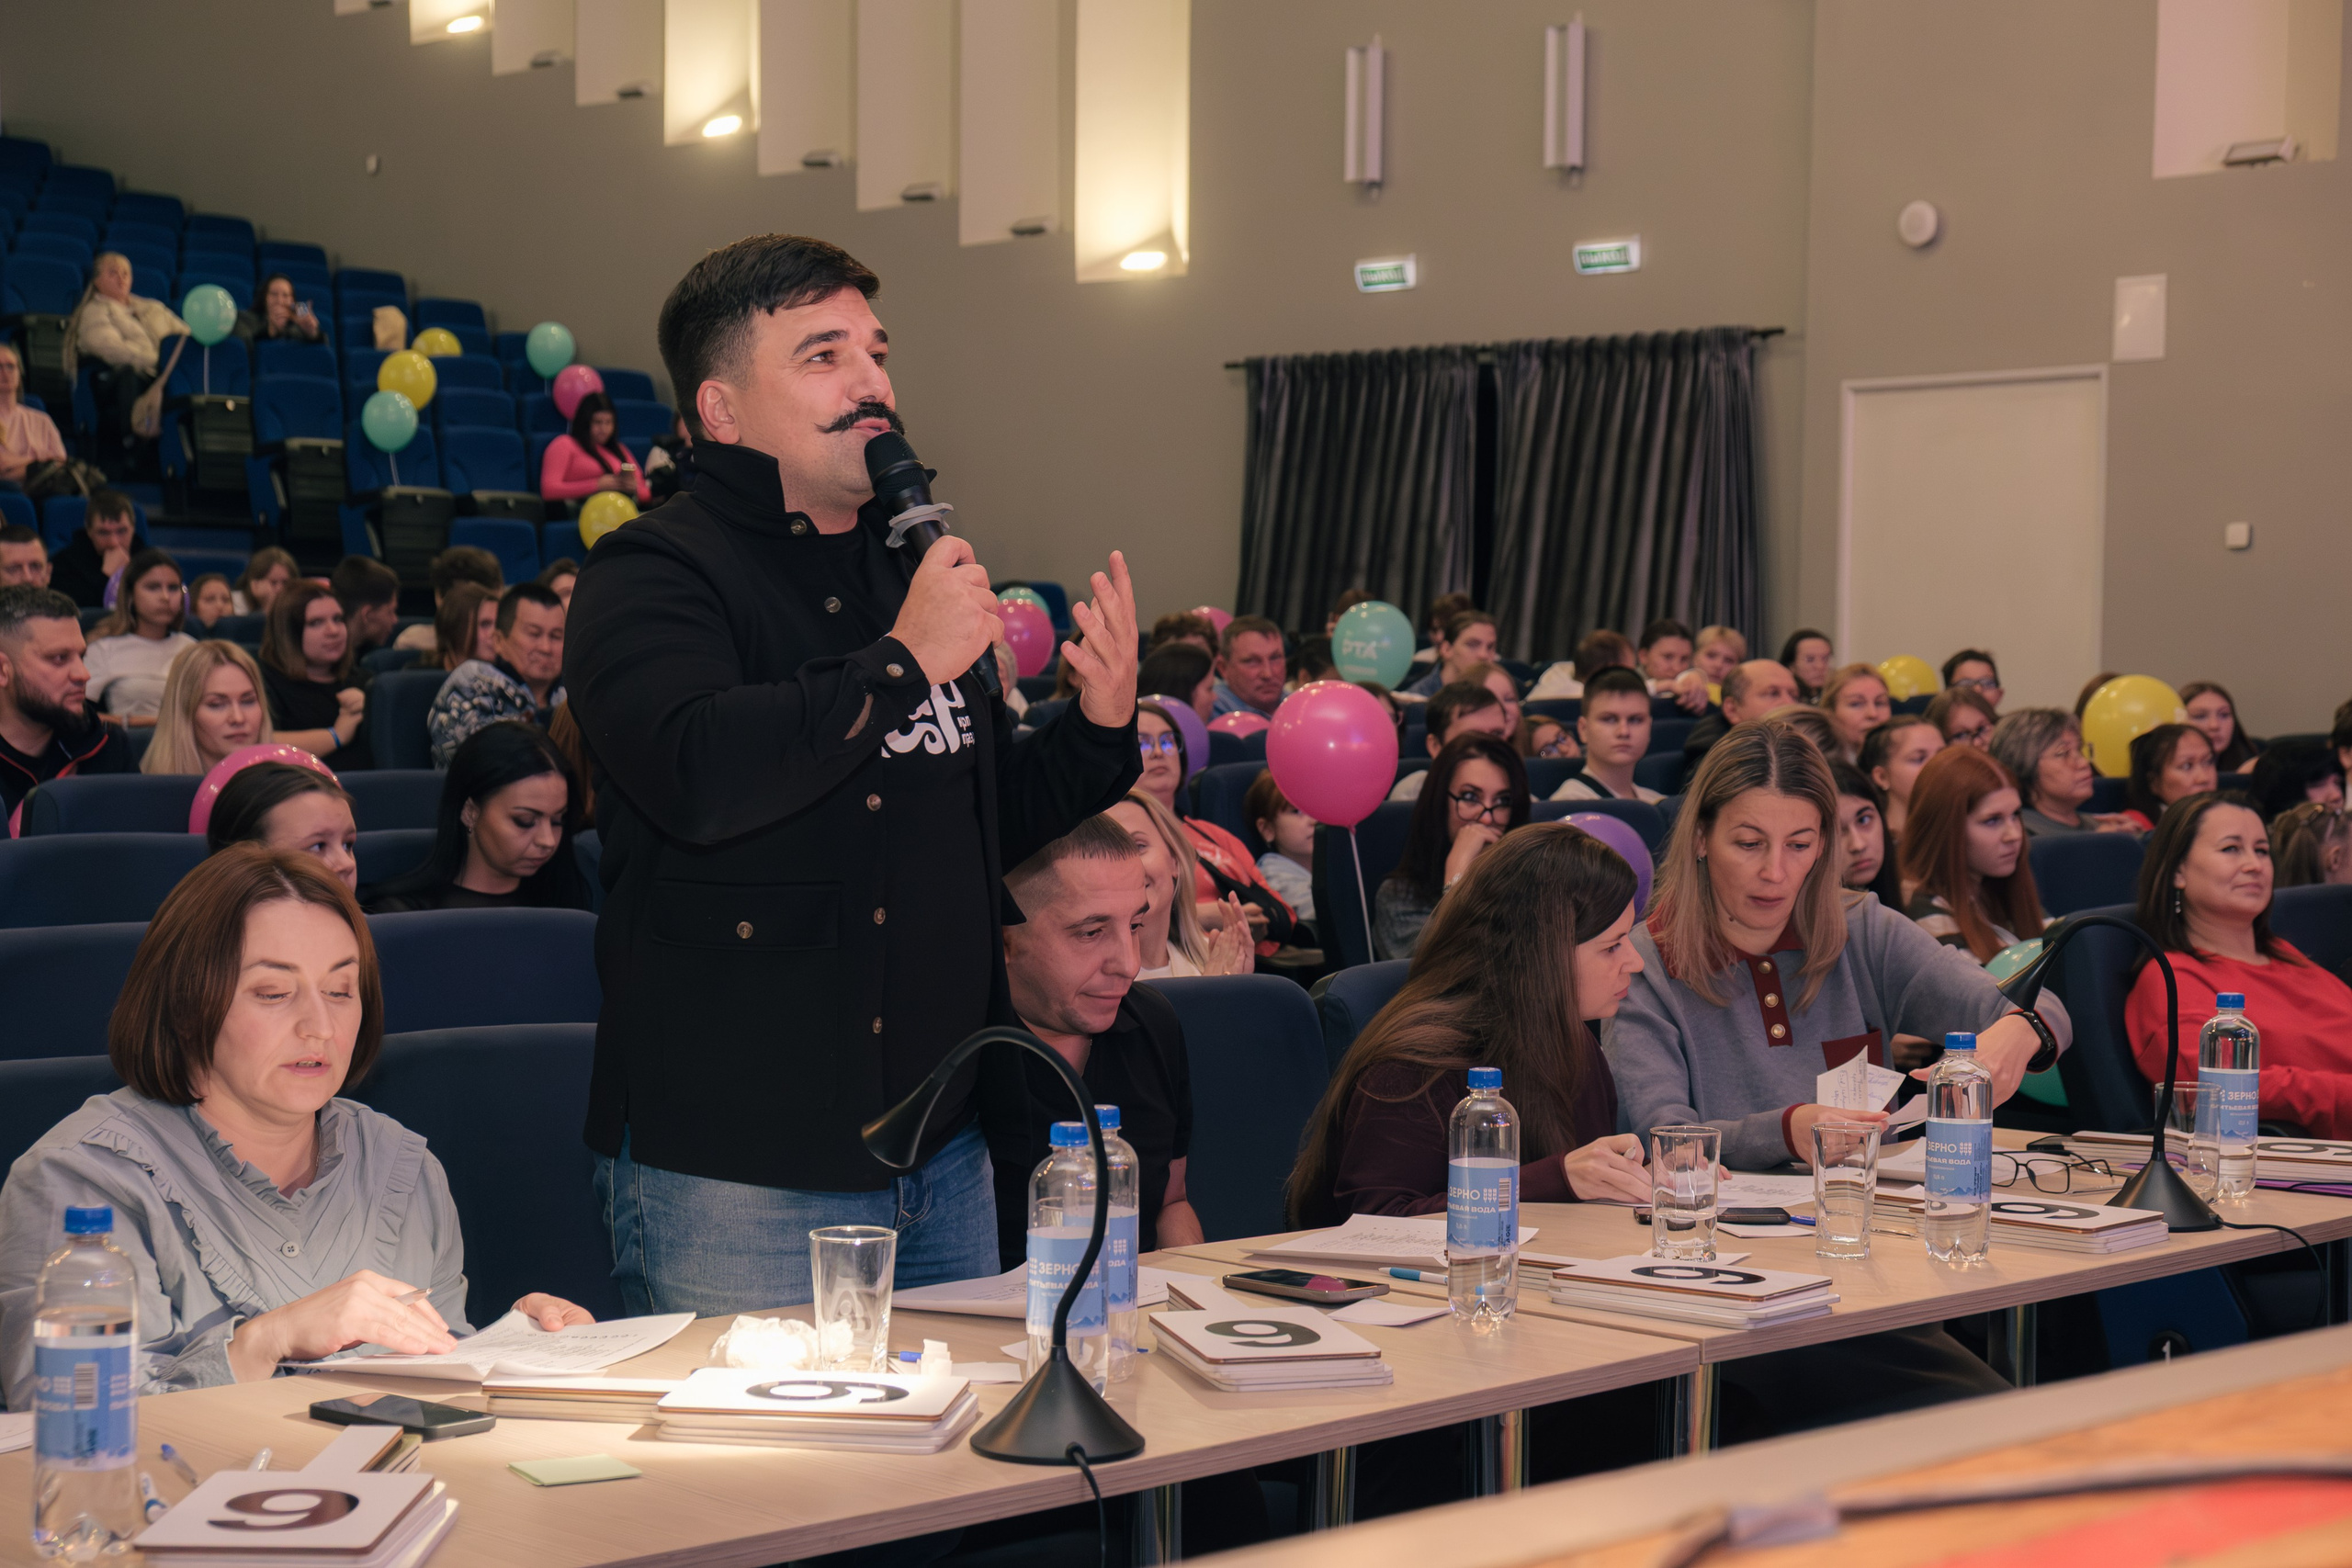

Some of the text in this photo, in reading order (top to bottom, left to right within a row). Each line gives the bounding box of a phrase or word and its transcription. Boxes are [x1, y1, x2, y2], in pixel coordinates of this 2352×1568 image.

[1449, 1186, 1481, 1201] ЗЕРНО
[1108, 1258, 1126, 1267] ОДА
[1204, 1320, 1321, 1348] 9
[207, 1488, 359, 1531] 9
